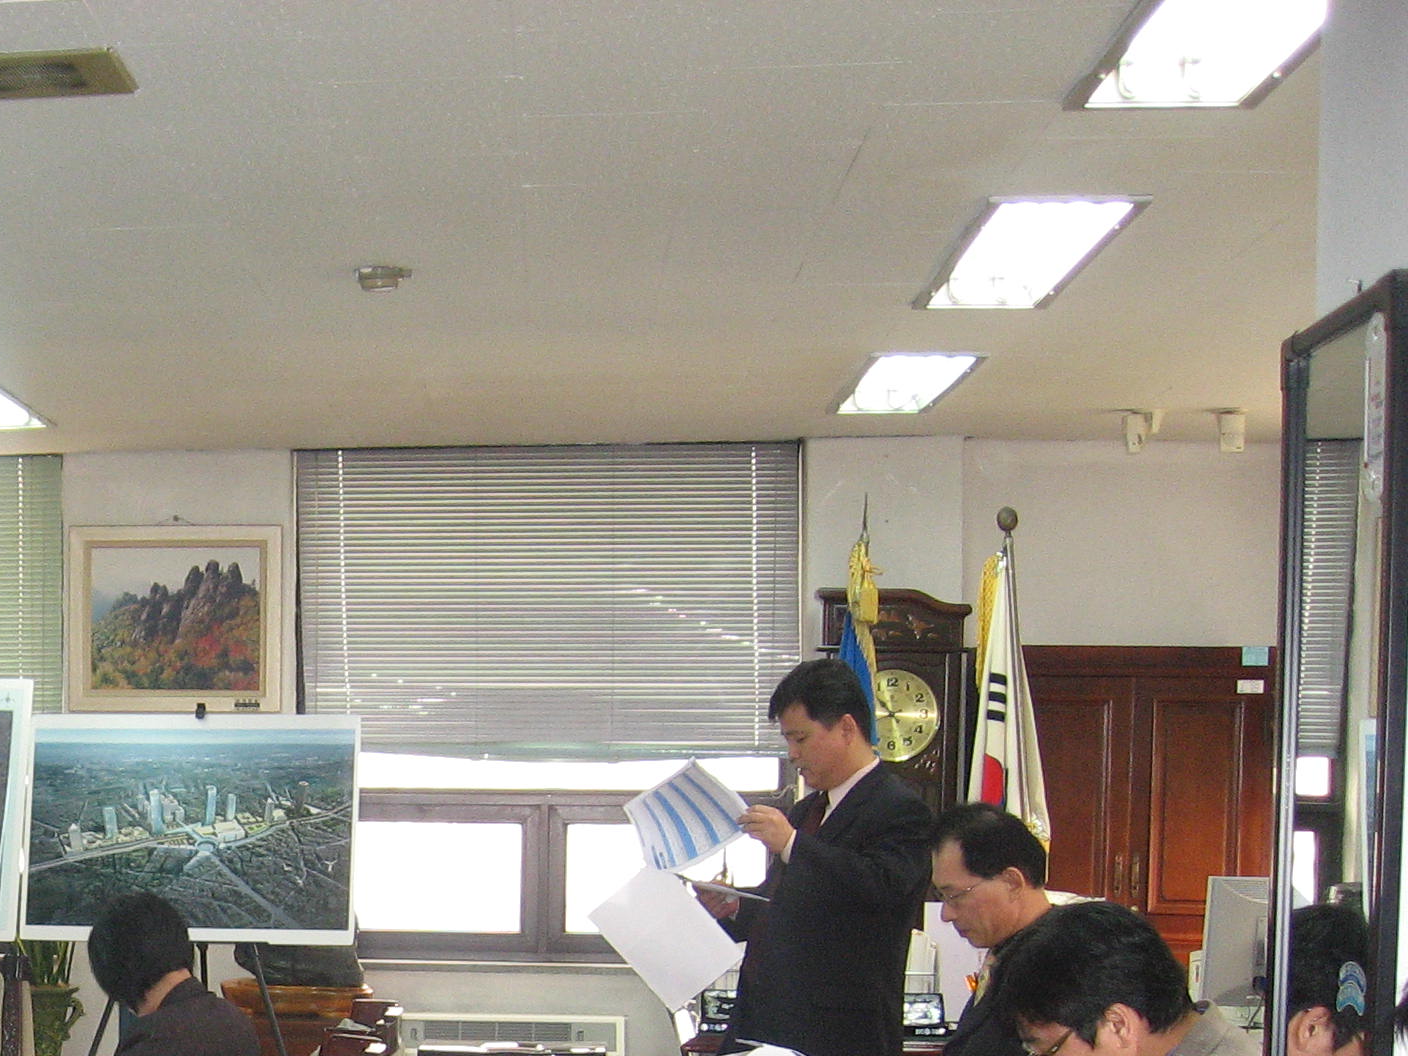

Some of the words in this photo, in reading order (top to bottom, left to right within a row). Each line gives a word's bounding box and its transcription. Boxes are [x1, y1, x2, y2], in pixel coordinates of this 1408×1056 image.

[887, 677, 899, 687] 12
[915, 692, 925, 703] 2
[919, 708, 929, 720] 3
[914, 724, 923, 734] 4
[887, 740, 896, 750] 6
[902, 736, 912, 746] 5
